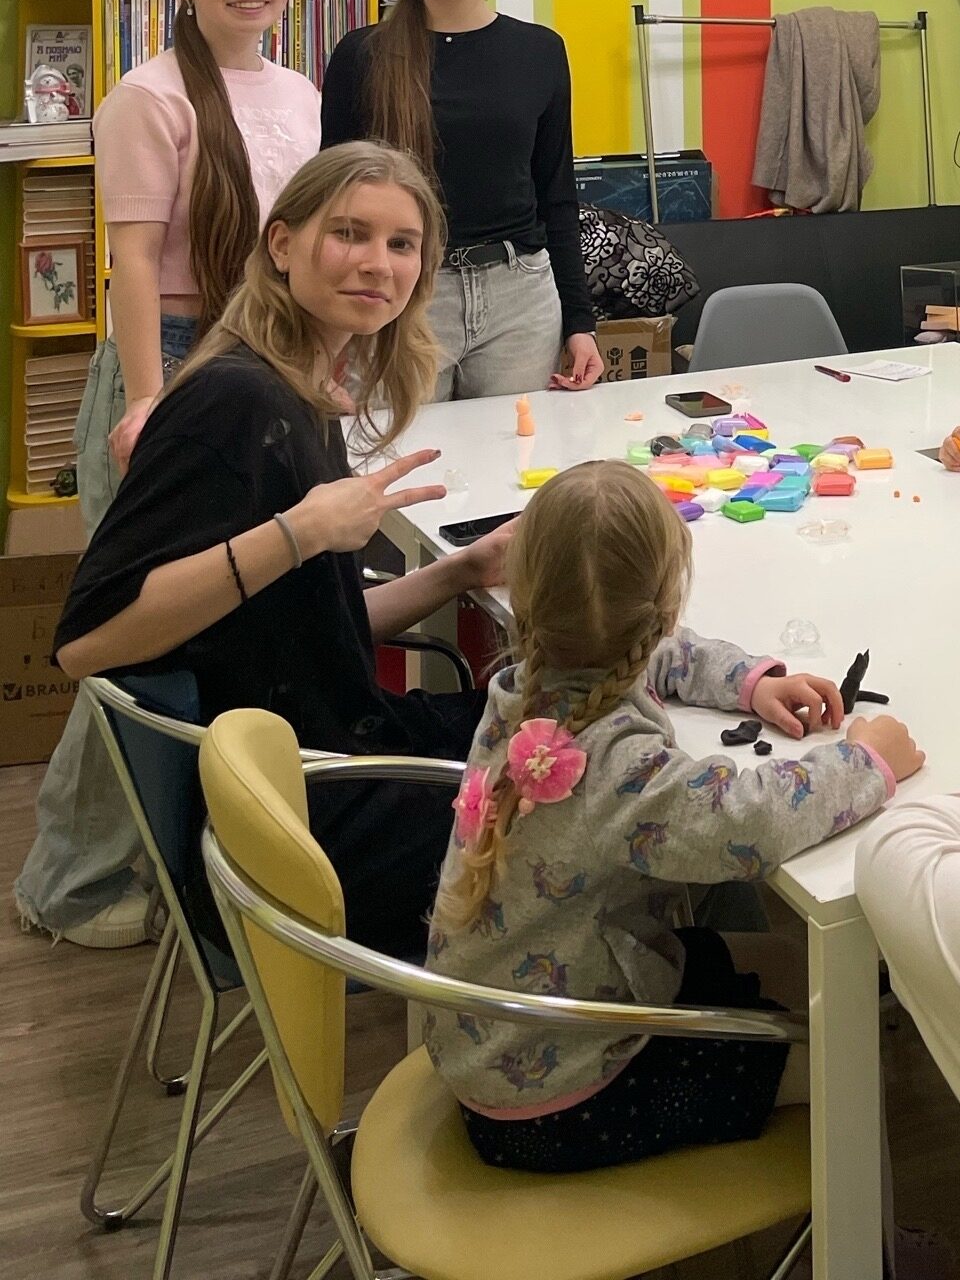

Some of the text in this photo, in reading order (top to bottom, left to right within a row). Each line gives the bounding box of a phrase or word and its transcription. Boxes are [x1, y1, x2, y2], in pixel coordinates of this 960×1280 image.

[45, 46, 82, 55] ПОЗНАЮ
[48, 54, 68, 63] МИР
[633, 362, 646, 370] UP
